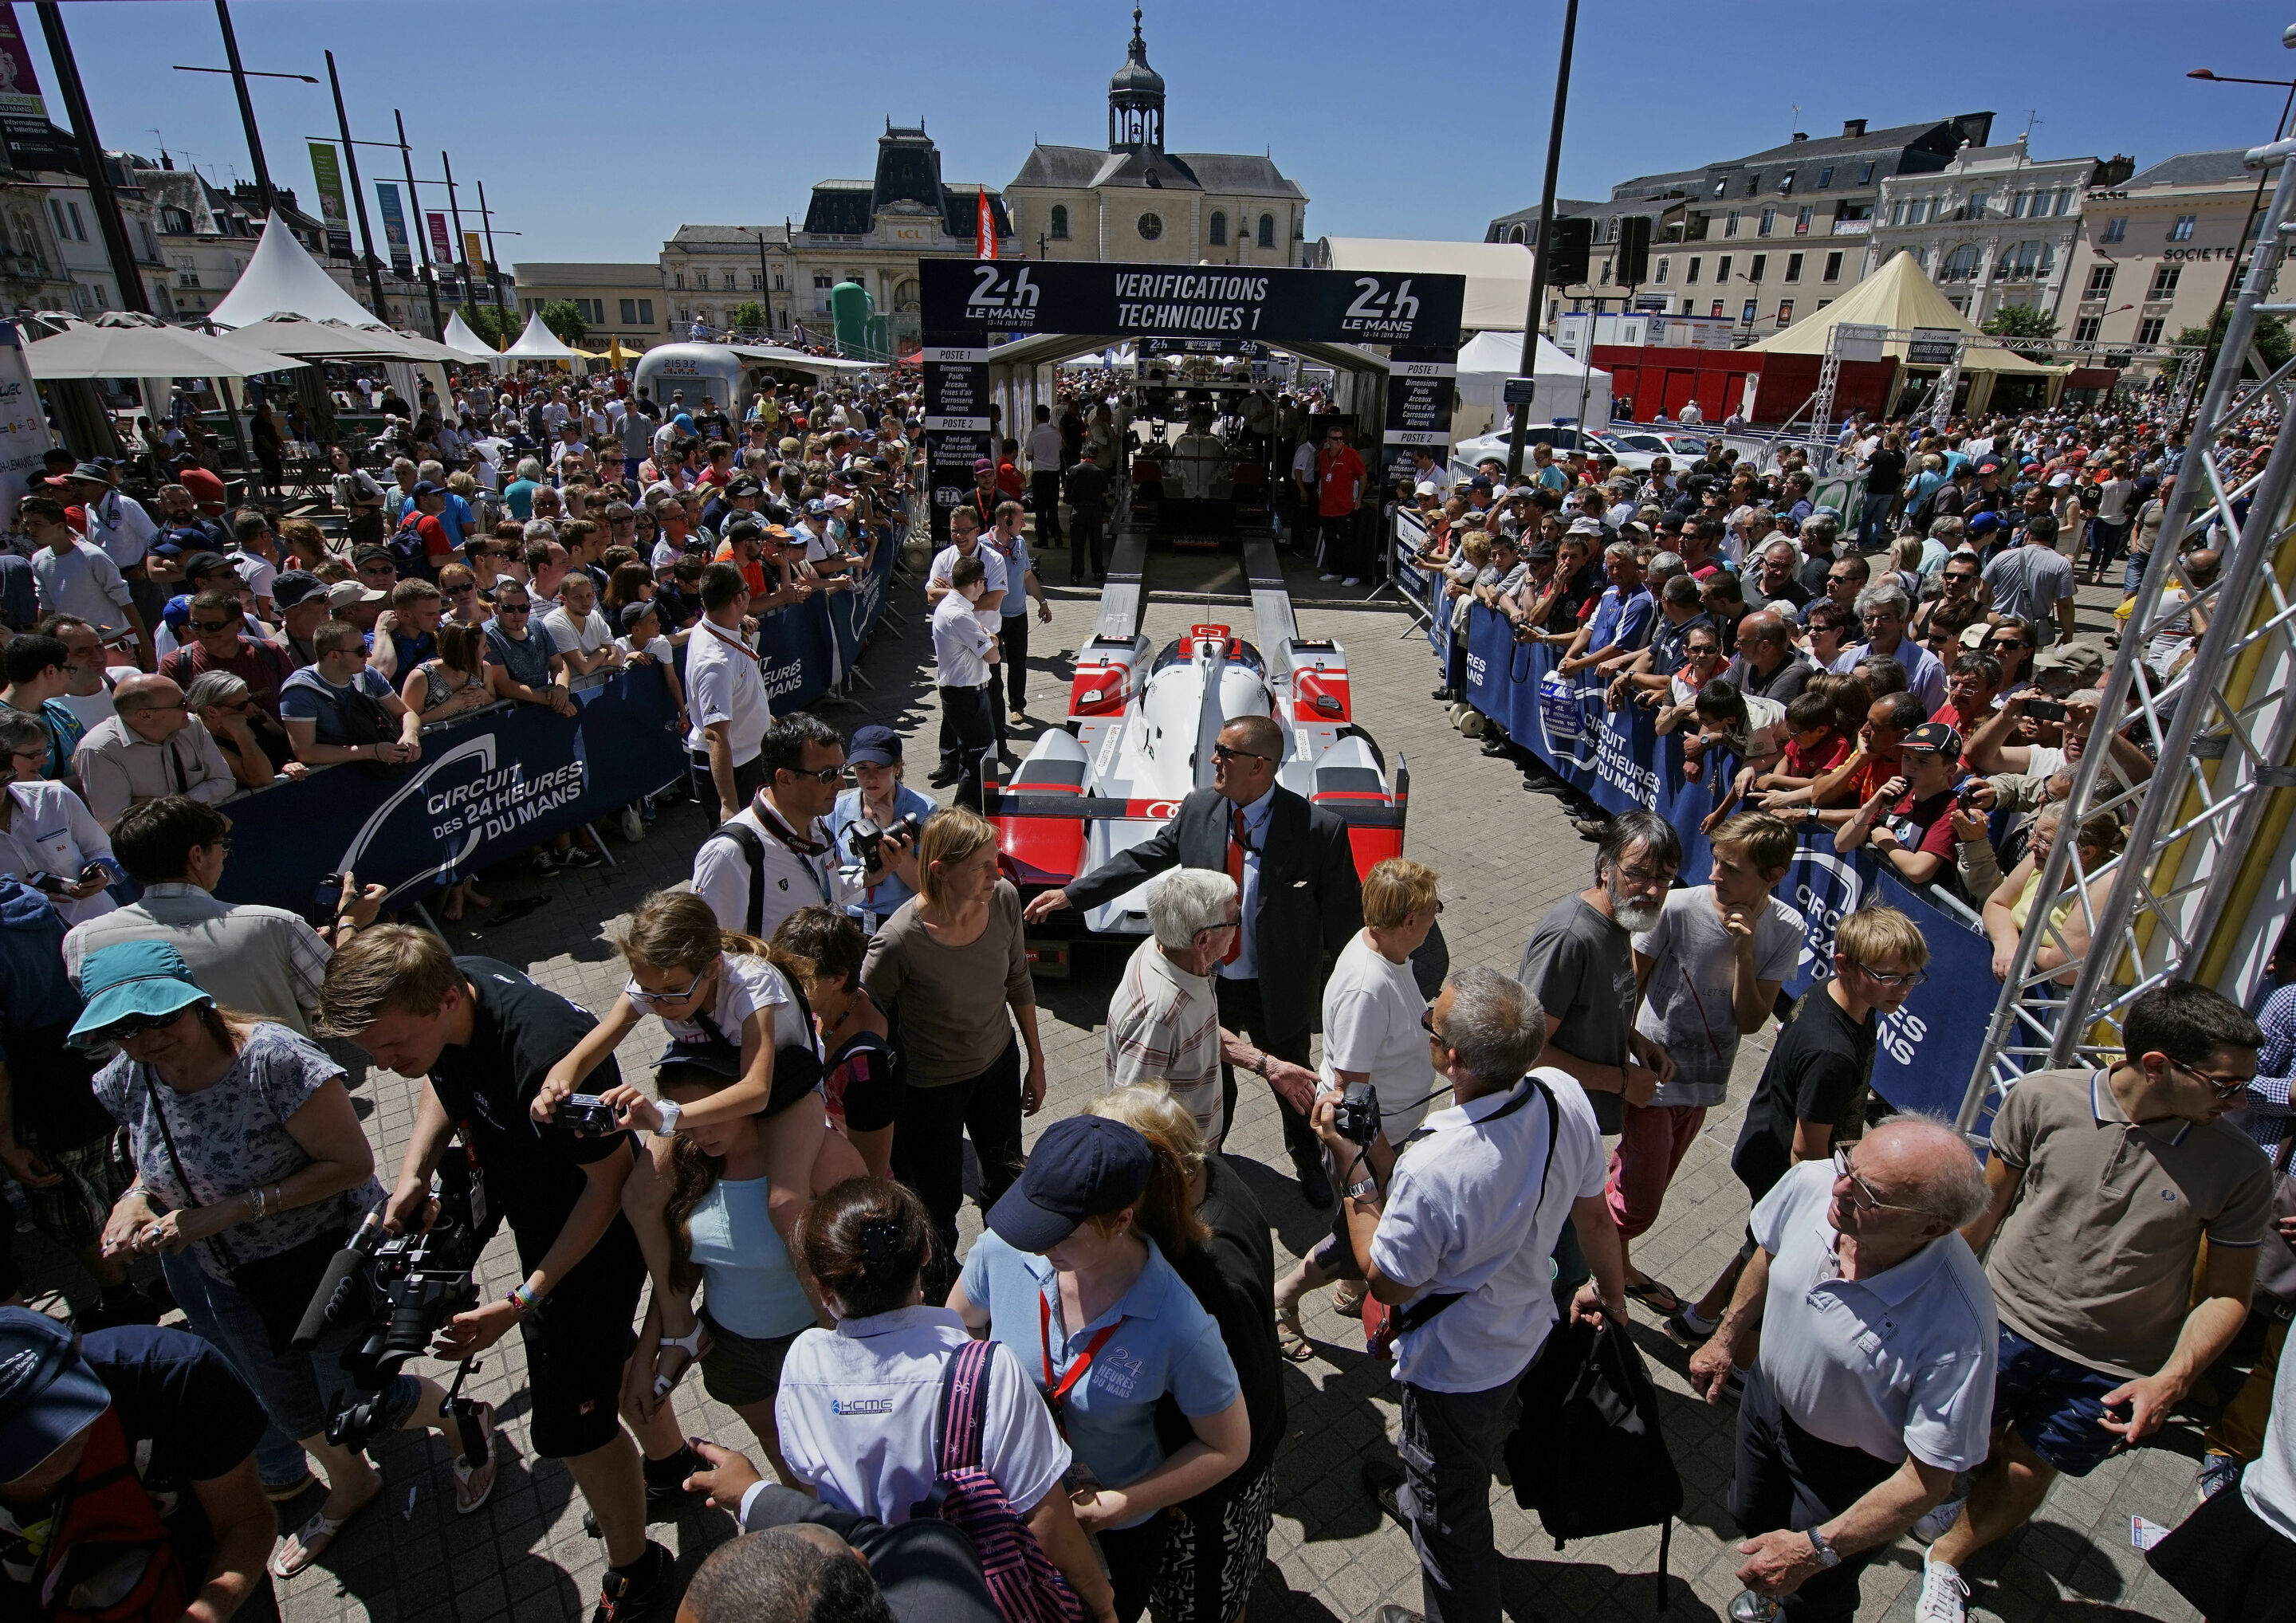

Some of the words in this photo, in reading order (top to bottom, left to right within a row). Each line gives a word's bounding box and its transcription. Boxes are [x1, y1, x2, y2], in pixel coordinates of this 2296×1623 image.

[10, 104, 33, 113] MANS
[898, 230, 923, 239] LCL
[2163, 248, 2235, 260] SOCIETE
[968, 265, 1040, 306] 24h
[1115, 273, 1269, 301] VERIFICATIONS
[1346, 277, 1420, 319] 24h
[965, 308, 985, 318] LE
[988, 308, 1036, 320] MANS
[1119, 304, 1244, 330] TECHNIQUES
[1251, 308, 1261, 331] 1
[1342, 319, 1362, 329] LE
[1365, 320, 1413, 332] MANS
[1150, 339, 1168, 349] 24h
[1240, 341, 1257, 351] 24h
[1913, 344, 1933, 353] ENTRÉE
[1933, 345, 1952, 354] PIÉTONS
[664, 360, 696, 368] 21532
[940, 350, 965, 360] POSTE
[967, 351, 971, 360] 1
[1407, 365, 1433, 374] POSTE
[1435, 366, 1439, 375] 1
[942, 419, 967, 428] POSTE
[969, 419, 973, 428] 2
[1401, 433, 1425, 442] POSTE
[1427, 434, 1433, 442] 2
[2088, 489, 2098, 498] 67
[763, 658, 801, 686] EURES
[1467, 653, 1486, 673] RES
[1110, 725, 1120, 737] Audi
[1584, 713, 1626, 752] CIRCUIT
[1105, 735, 1115, 750] e-tron
[1098, 749, 1111, 768] quattro
[1596, 739, 1607, 760] 24
[1606, 751, 1661, 794] HEURES
[427, 763, 522, 815] CIRCUIT
[1597, 760, 1613, 782] DU
[1614, 772, 1657, 812] MANS
[433, 817, 463, 840] DES
[465, 799, 493, 824] 24
[495, 760, 583, 812] HEURES
[486, 812, 516, 841] DU
[517, 781, 581, 826] MANS
[786, 835, 811, 851] Canon
[1795, 884, 1841, 932] CIRC
[1809, 927, 1837, 960] 24
[1810, 958, 1829, 980] D
[1877, 1020, 1916, 1066] NS
[454, 1222, 466, 1239] SONY
[1104, 1346, 1144, 1378] 24
[1092, 1374, 1106, 1387] DU
[1105, 1382, 1132, 1398] MANS
[1097, 1364, 1137, 1389] HEURES
[841, 1398, 894, 1411] KCMG
